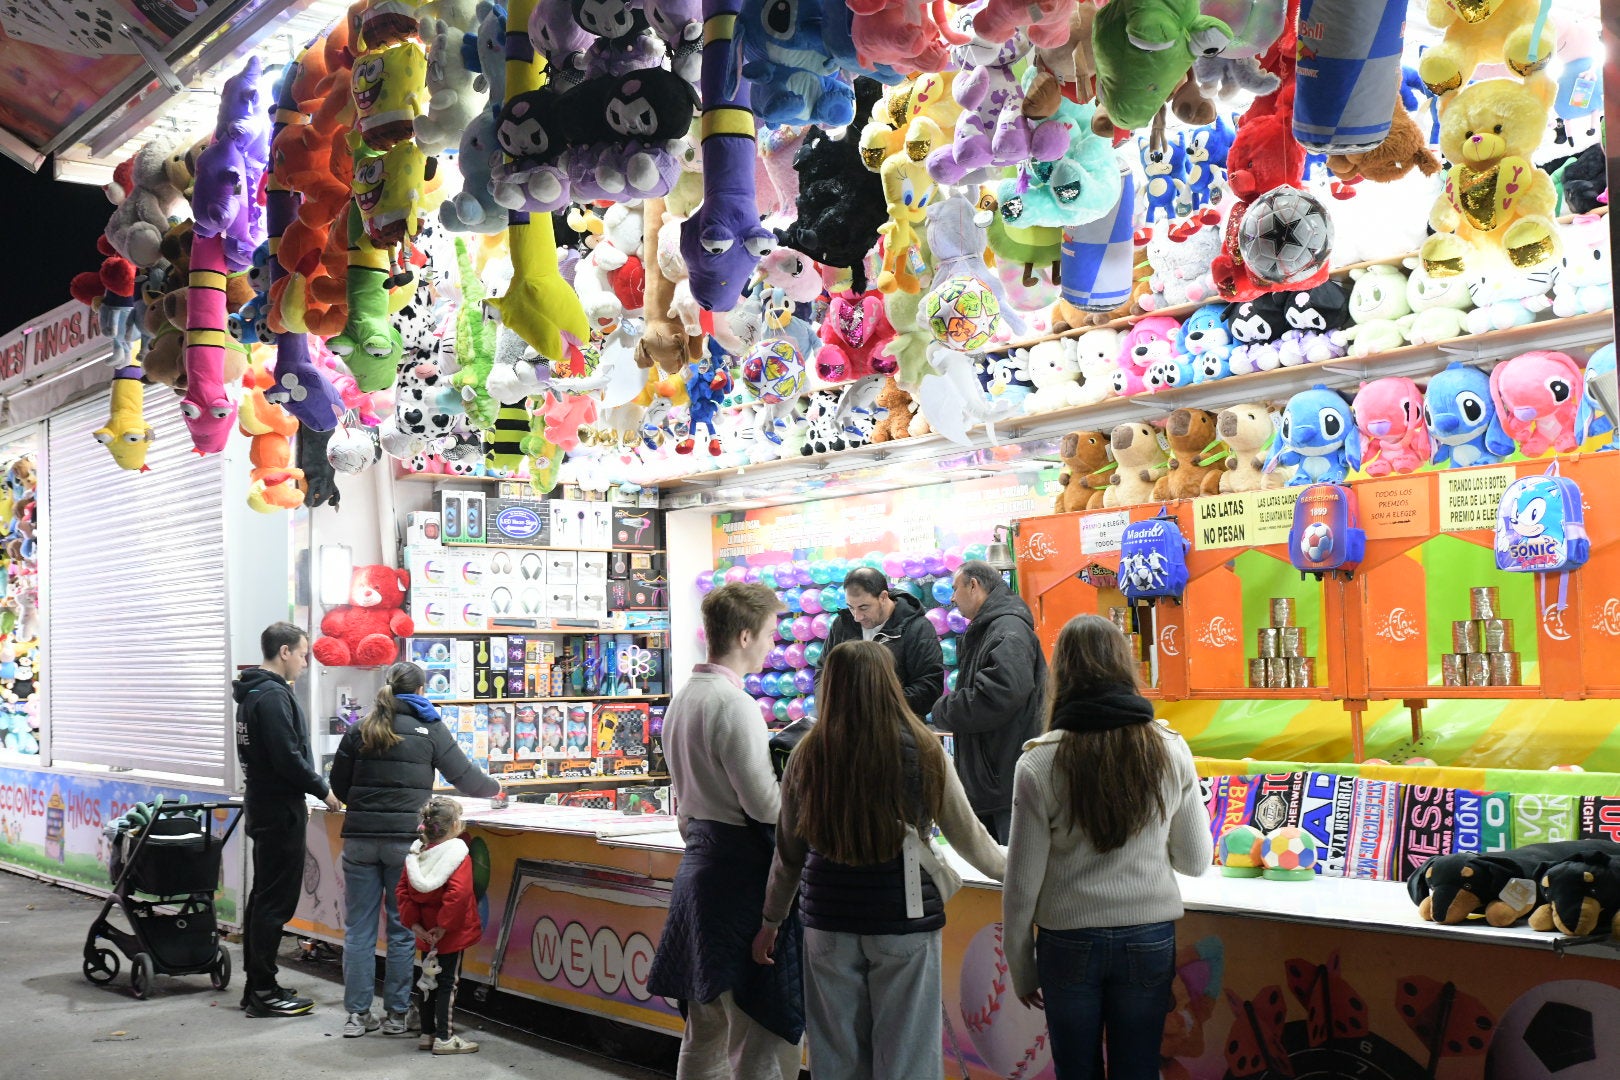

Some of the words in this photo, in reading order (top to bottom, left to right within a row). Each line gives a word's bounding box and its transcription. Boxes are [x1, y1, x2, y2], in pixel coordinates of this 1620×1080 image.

[1448, 478, 1472, 493] TIRANDO
[1473, 477, 1483, 491] LOS
[1489, 475, 1507, 490] BOTES
[1300, 494, 1339, 504] BARCELONA
[1375, 490, 1397, 499] TODOS
[1400, 488, 1413, 497] LOS
[1449, 496, 1468, 507] FUERA
[1470, 494, 1478, 506] DE
[1479, 494, 1487, 506] LA
[1201, 503, 1217, 520] LAS
[1218, 499, 1244, 518] LATAS
[1257, 498, 1266, 508] LAS
[1267, 496, 1281, 507] LATAS
[1378, 499, 1408, 509] PREMIOS
[1371, 512, 1385, 522] SON
[1386, 511, 1391, 519] A
[1392, 509, 1417, 519] ELEGIR
[1450, 510, 1475, 523] PREMIO
[1476, 509, 1481, 521] A
[1127, 525, 1158, 540] Madrid
[1203, 527, 1216, 545] NO
[1217, 523, 1245, 543] PESAN
[1510, 543, 1556, 558] SONIC
[1334, 779, 1353, 832] HISTORIA
[1387, 789, 1395, 819] LEAGUE
[1444, 815, 1453, 827] &
[1332, 833, 1348, 848] LA
[536, 932, 649, 985] WELC
